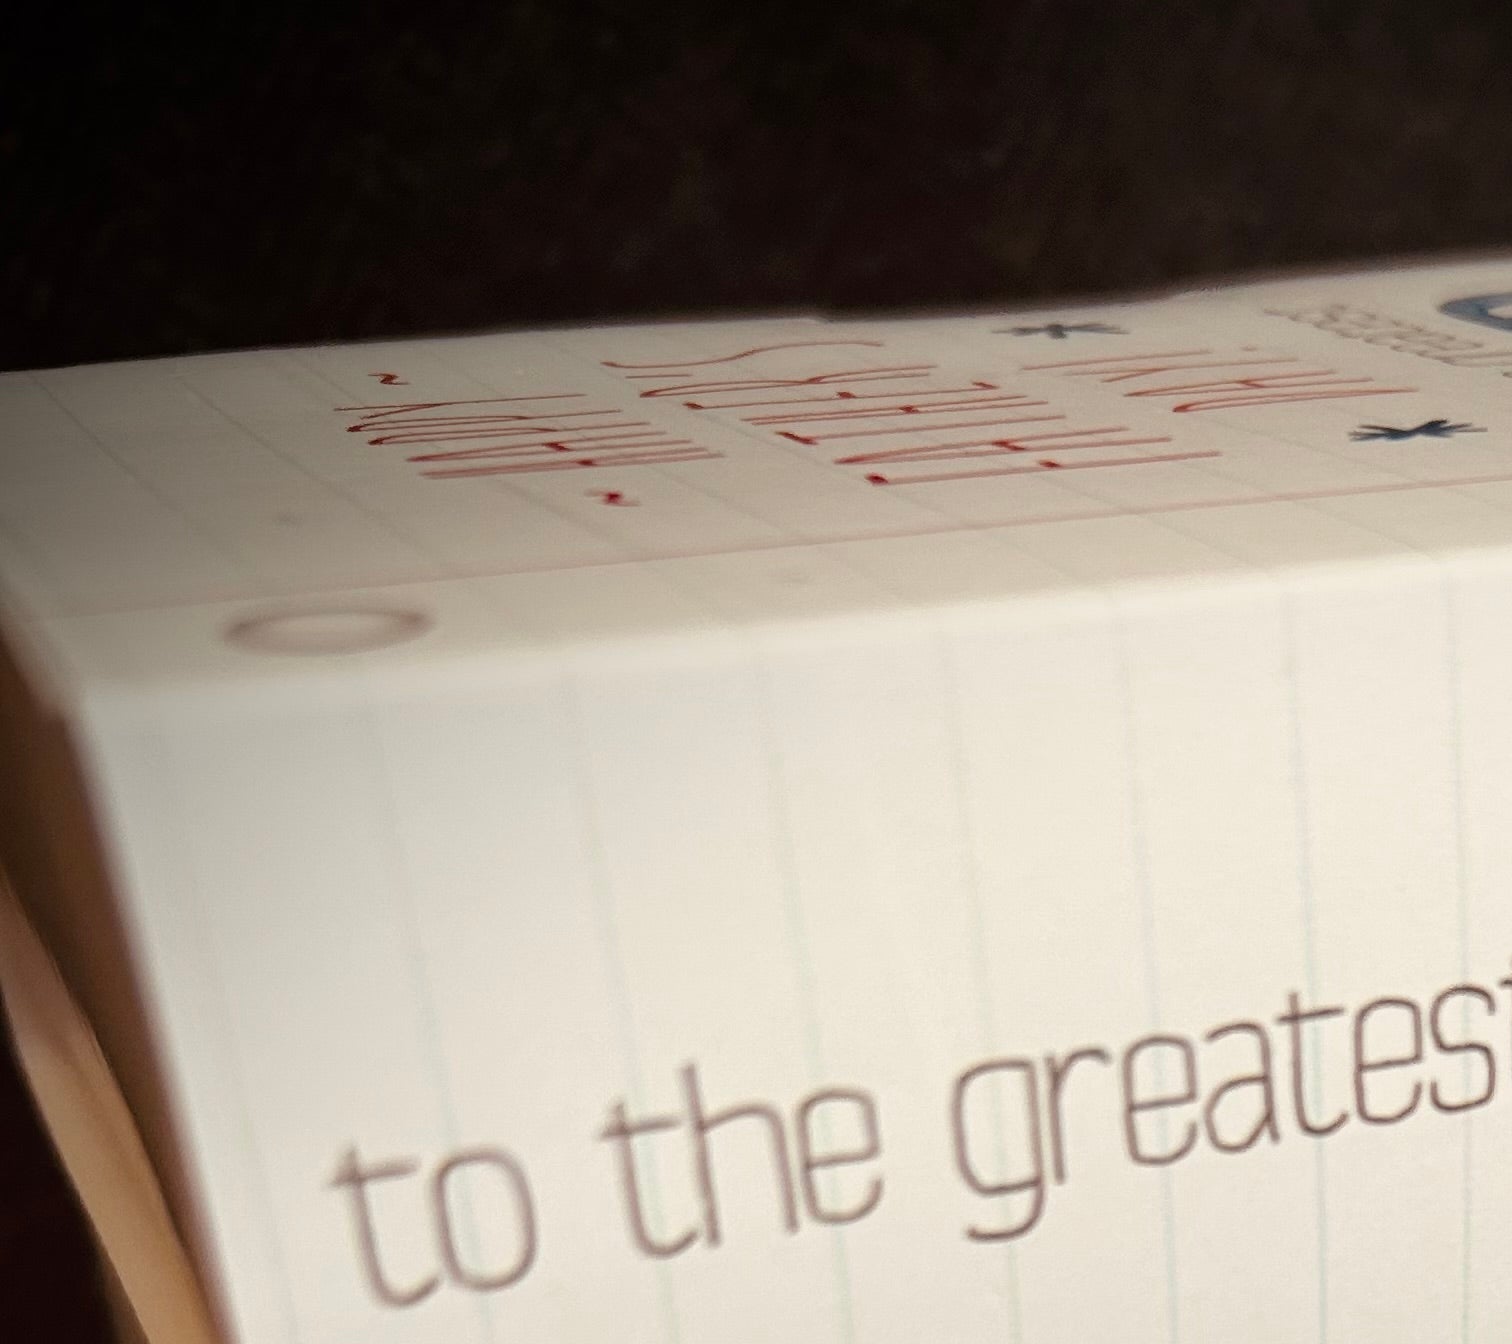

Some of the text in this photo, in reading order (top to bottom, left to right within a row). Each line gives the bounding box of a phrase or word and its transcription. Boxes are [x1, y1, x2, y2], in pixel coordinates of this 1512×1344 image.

[334, 393, 725, 479] HAPPY
[602, 340, 1222, 485] FATHER'S
[1021, 347, 1418, 413] DAY!
[330, 1145, 537, 1308] to
[598, 1060, 884, 1261] the
